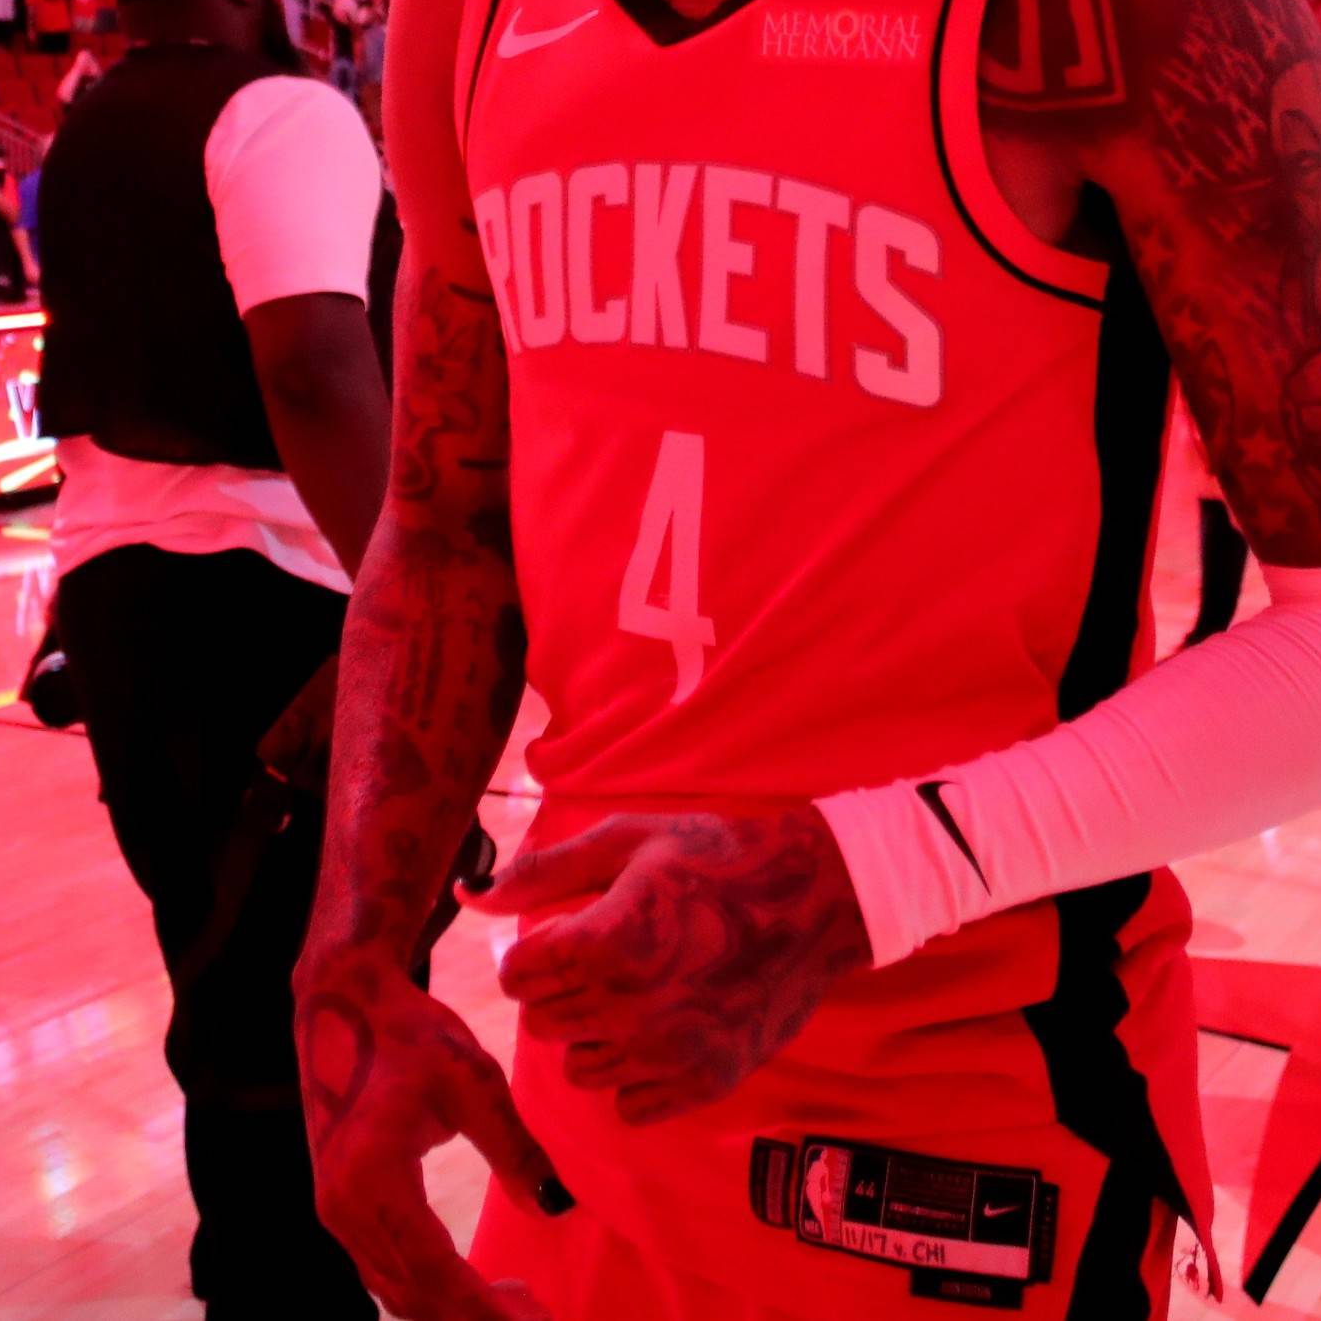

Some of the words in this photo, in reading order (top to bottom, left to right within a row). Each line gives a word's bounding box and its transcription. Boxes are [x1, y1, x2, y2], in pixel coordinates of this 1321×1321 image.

[763, 8, 922, 40] MEMORIAL
[762, 32, 920, 60] HERMANN
[474, 162, 945, 410] ROCKETS
[616, 429, 717, 705] 4
[912, 1239, 946, 1265] CHI
